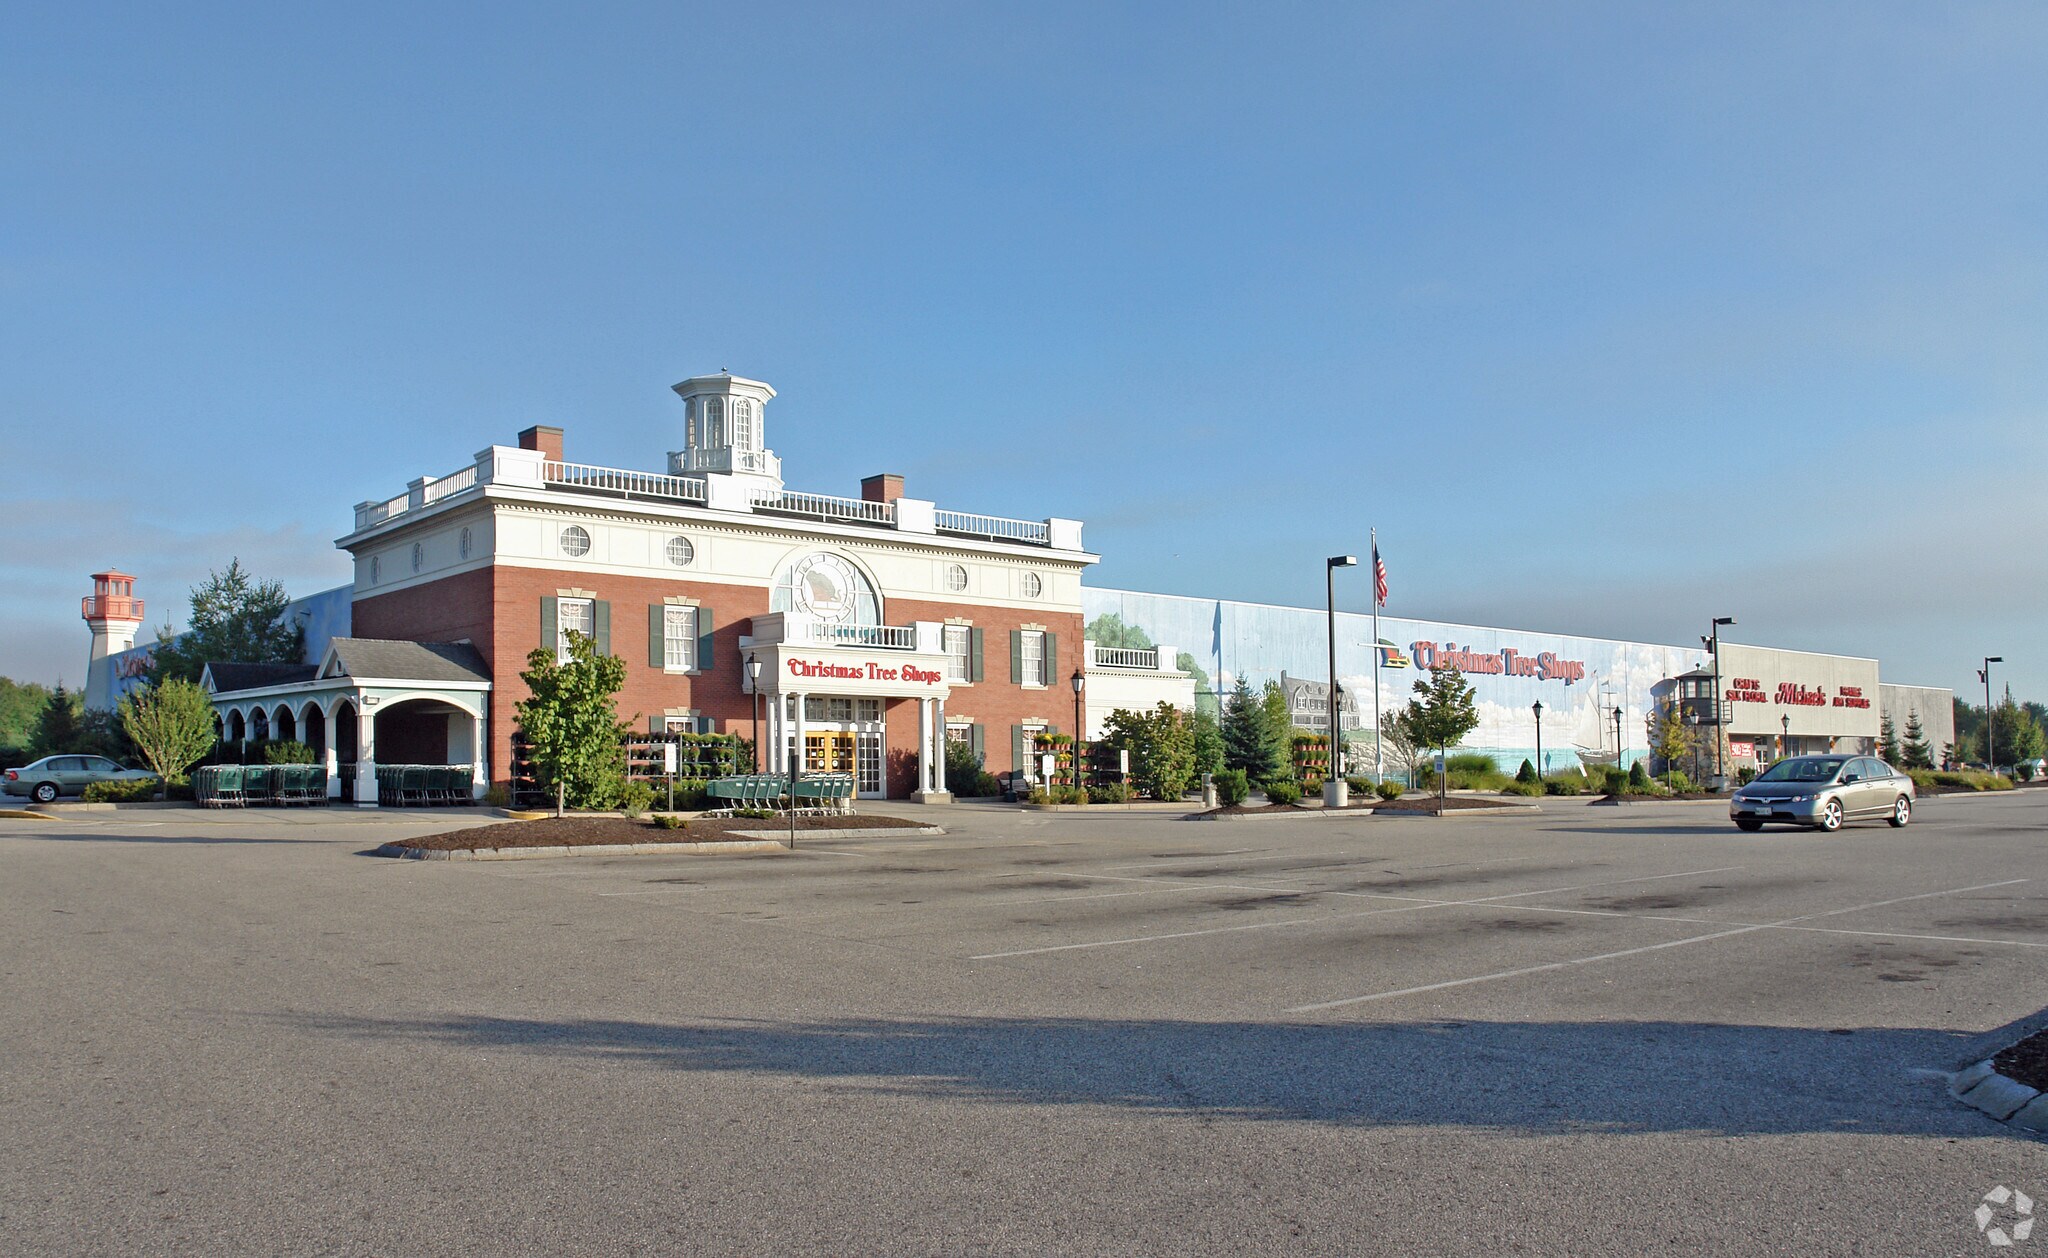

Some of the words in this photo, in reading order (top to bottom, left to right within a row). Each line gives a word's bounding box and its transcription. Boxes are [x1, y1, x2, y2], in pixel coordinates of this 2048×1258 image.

[787, 658, 864, 679] Christmas
[865, 662, 897, 680] Tree
[901, 664, 941, 685] Shops
[1410, 641, 1504, 674] Christmas
[1501, 648, 1539, 677] Tree
[1538, 652, 1585, 686] Shops
[1774, 682, 1826, 707] Michaels
